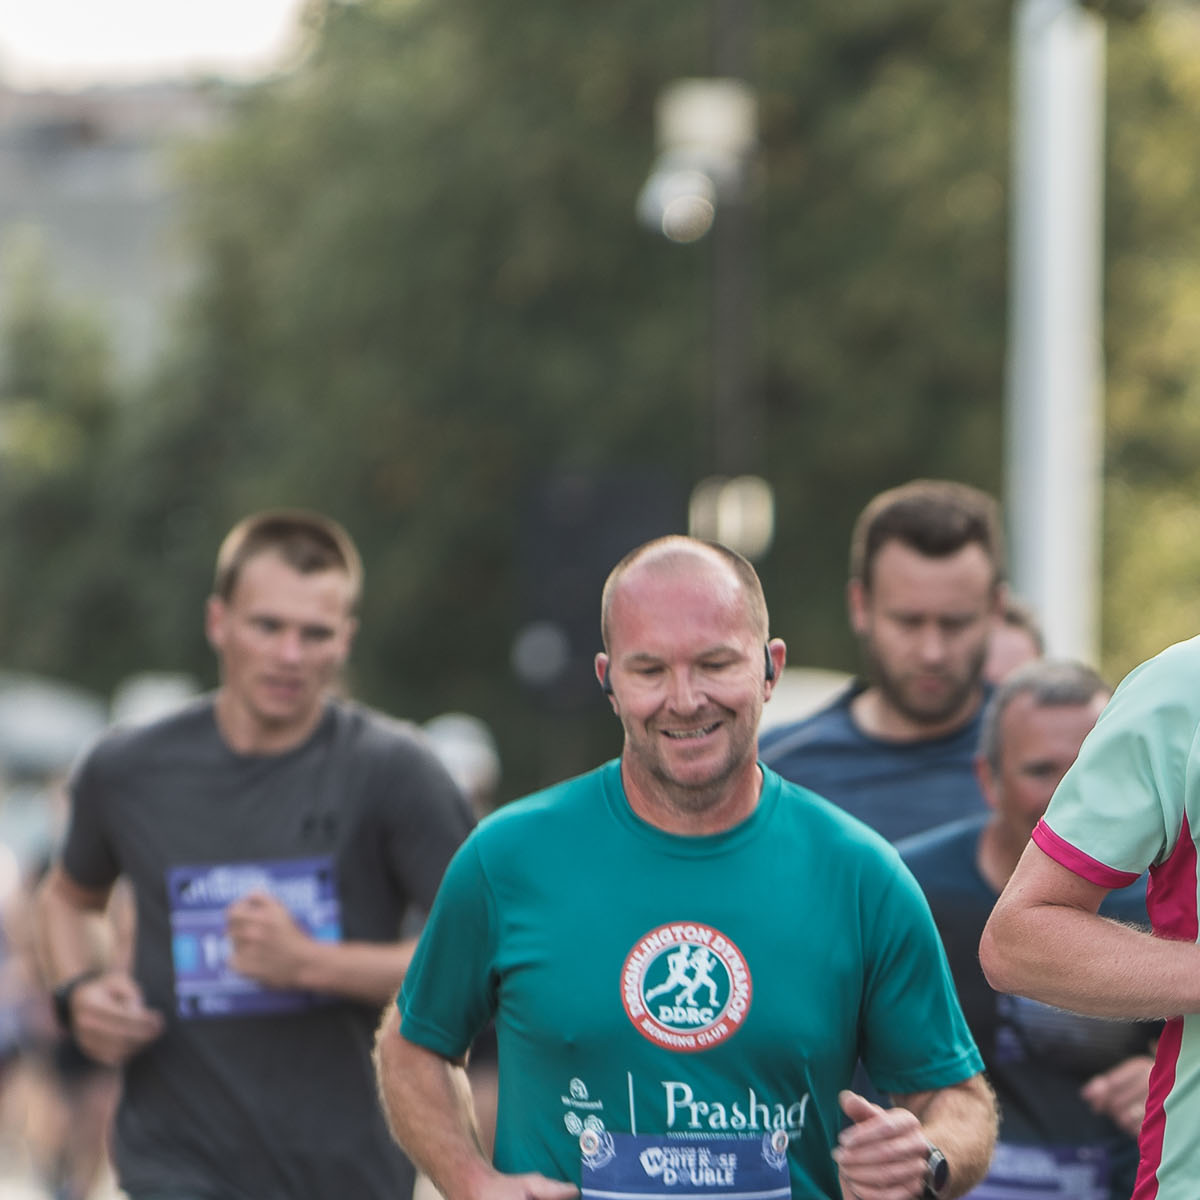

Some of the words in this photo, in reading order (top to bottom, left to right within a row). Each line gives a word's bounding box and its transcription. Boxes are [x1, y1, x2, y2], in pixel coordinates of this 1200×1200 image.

[624, 925, 713, 1019] DRIGHLINGTON
[710, 935, 749, 1025] DYNAMOS
[640, 1018, 697, 1048] RUNNING
[696, 1022, 729, 1046] CLUB
[659, 1005, 714, 1025] DDRC
[661, 1081, 810, 1131] Prashad
